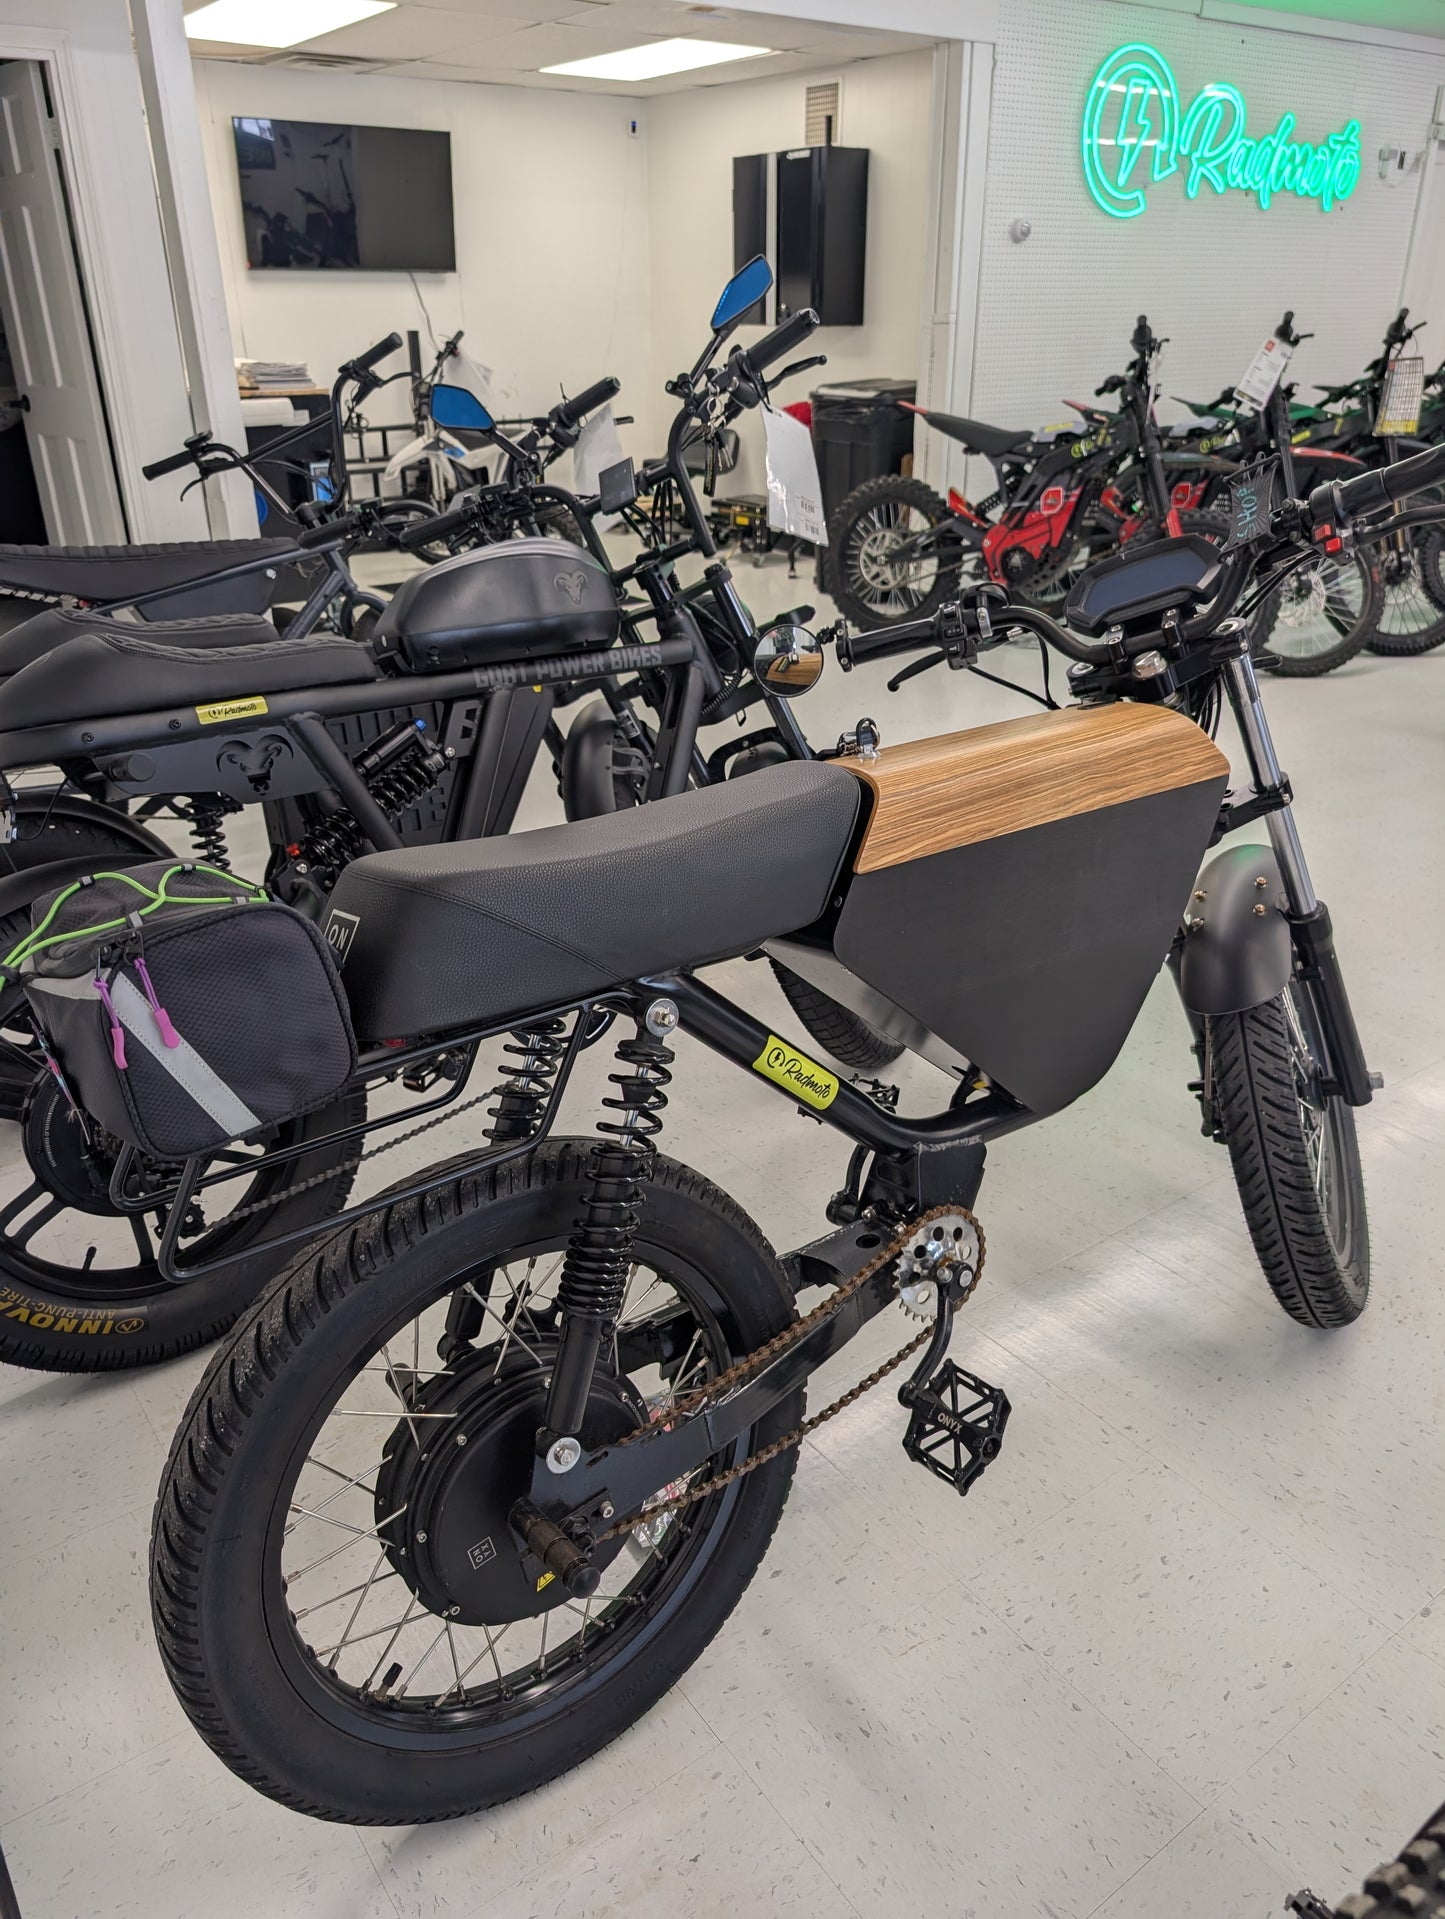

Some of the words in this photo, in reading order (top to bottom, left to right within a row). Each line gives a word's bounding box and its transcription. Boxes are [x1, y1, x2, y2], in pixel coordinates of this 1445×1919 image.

[1179, 81, 1362, 213] Radmoto
[535, 652, 605, 681] POWER
[608, 645, 663, 671] BIKES
[782, 1058, 832, 1099] Radmoto
[937, 1412, 963, 1435] ONYX
